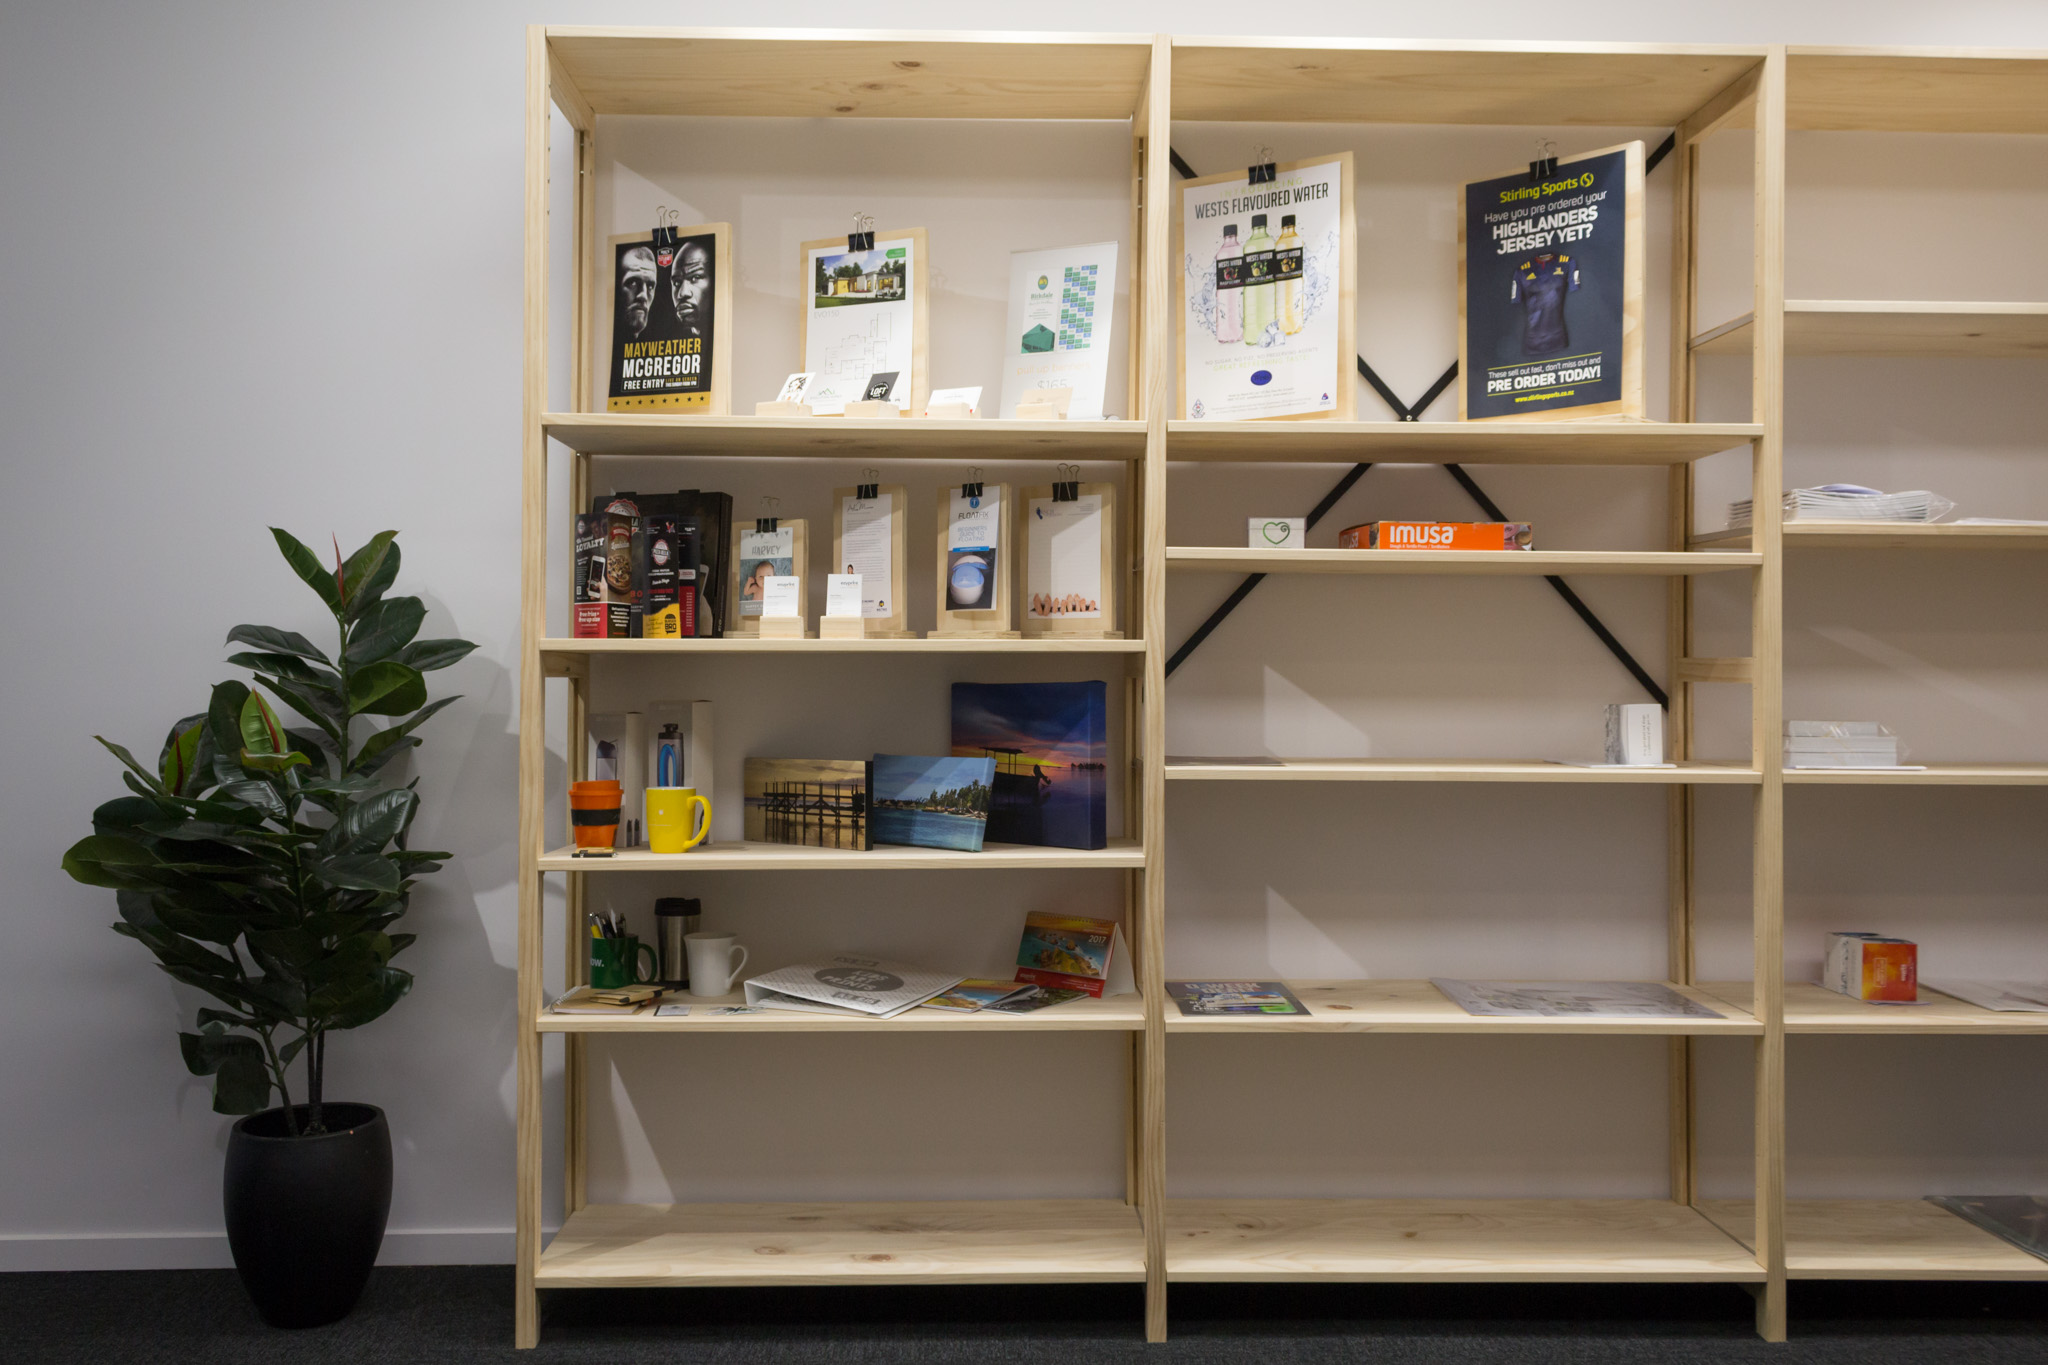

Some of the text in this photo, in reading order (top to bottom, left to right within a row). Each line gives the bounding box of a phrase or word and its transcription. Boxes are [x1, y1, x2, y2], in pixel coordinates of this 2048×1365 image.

[1220, 177, 1303, 199] INTRODUCING
[1500, 178, 1578, 203] Stirling Sports
[1194, 182, 1329, 219] WESTS FLAVOURED WATER
[1484, 190, 1608, 224] Have you pre ordered your
[1493, 205, 1599, 240] HIGHLANDERS
[1496, 223, 1594, 255] JERSEY YET?
[624, 337, 702, 358] MAYWEATHER
[622, 354, 701, 378] MCGREGOR
[1488, 371, 1507, 379] These
[1507, 368, 1519, 377] sell
[1519, 367, 1530, 375] out
[1561, 360, 1577, 368] miss
[1577, 358, 1588, 366] out
[1588, 355, 1602, 365] and
[623, 378, 665, 390] FREE ENTRY
[1487, 365, 1602, 393] PRE ORDER TODAY!
[576, 537, 605, 553] LOYALTY
[751, 545, 781, 556] HARVEY
[1088, 934, 1107, 944] 2017
